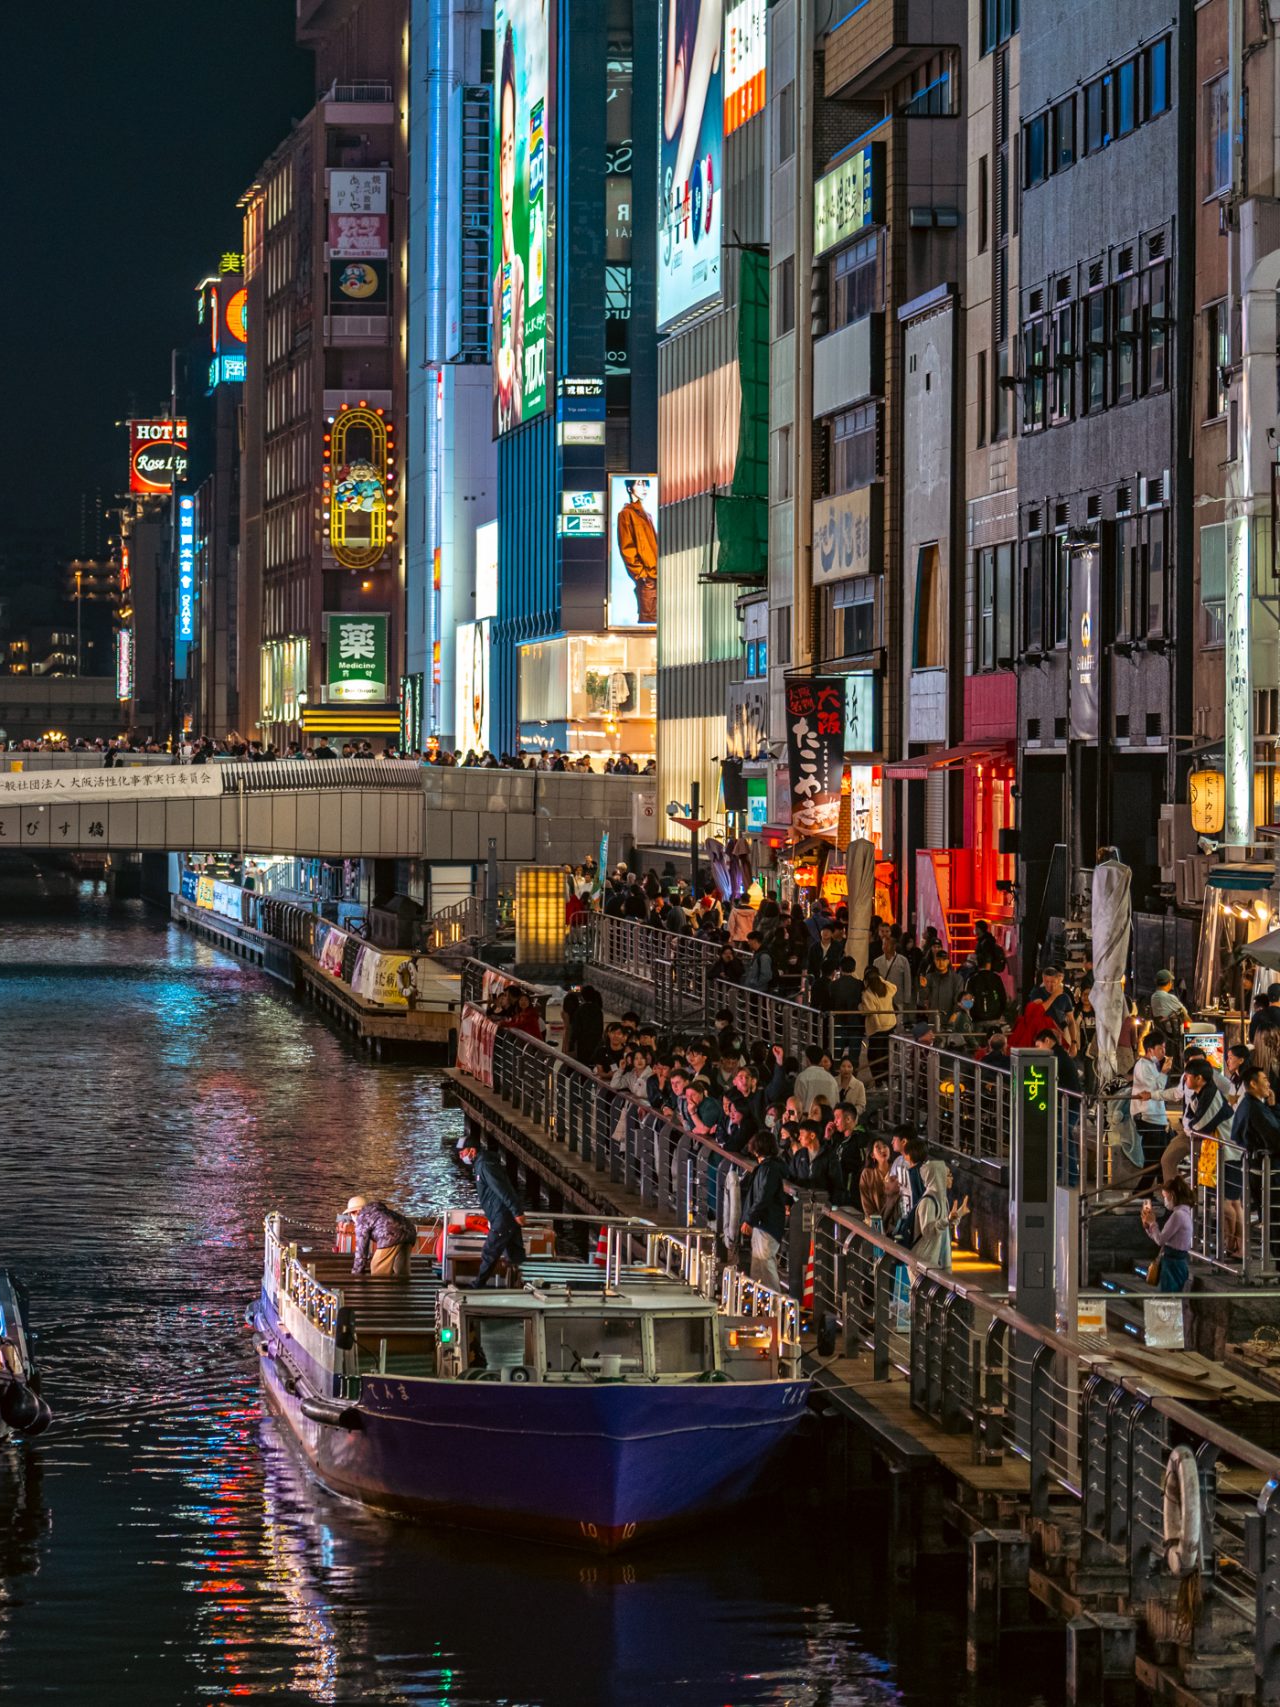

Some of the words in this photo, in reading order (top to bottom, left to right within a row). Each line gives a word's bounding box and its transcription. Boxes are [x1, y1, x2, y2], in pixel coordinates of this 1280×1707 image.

[137, 454, 165, 472] Rose
[340, 623, 375, 659] 薬
[817, 687, 841, 734] 大阪
[792, 716, 821, 826] たこやき
[367, 1383, 409, 1400] てんま
[580, 1520, 597, 1538] 10
[622, 1522, 636, 1539] 10
